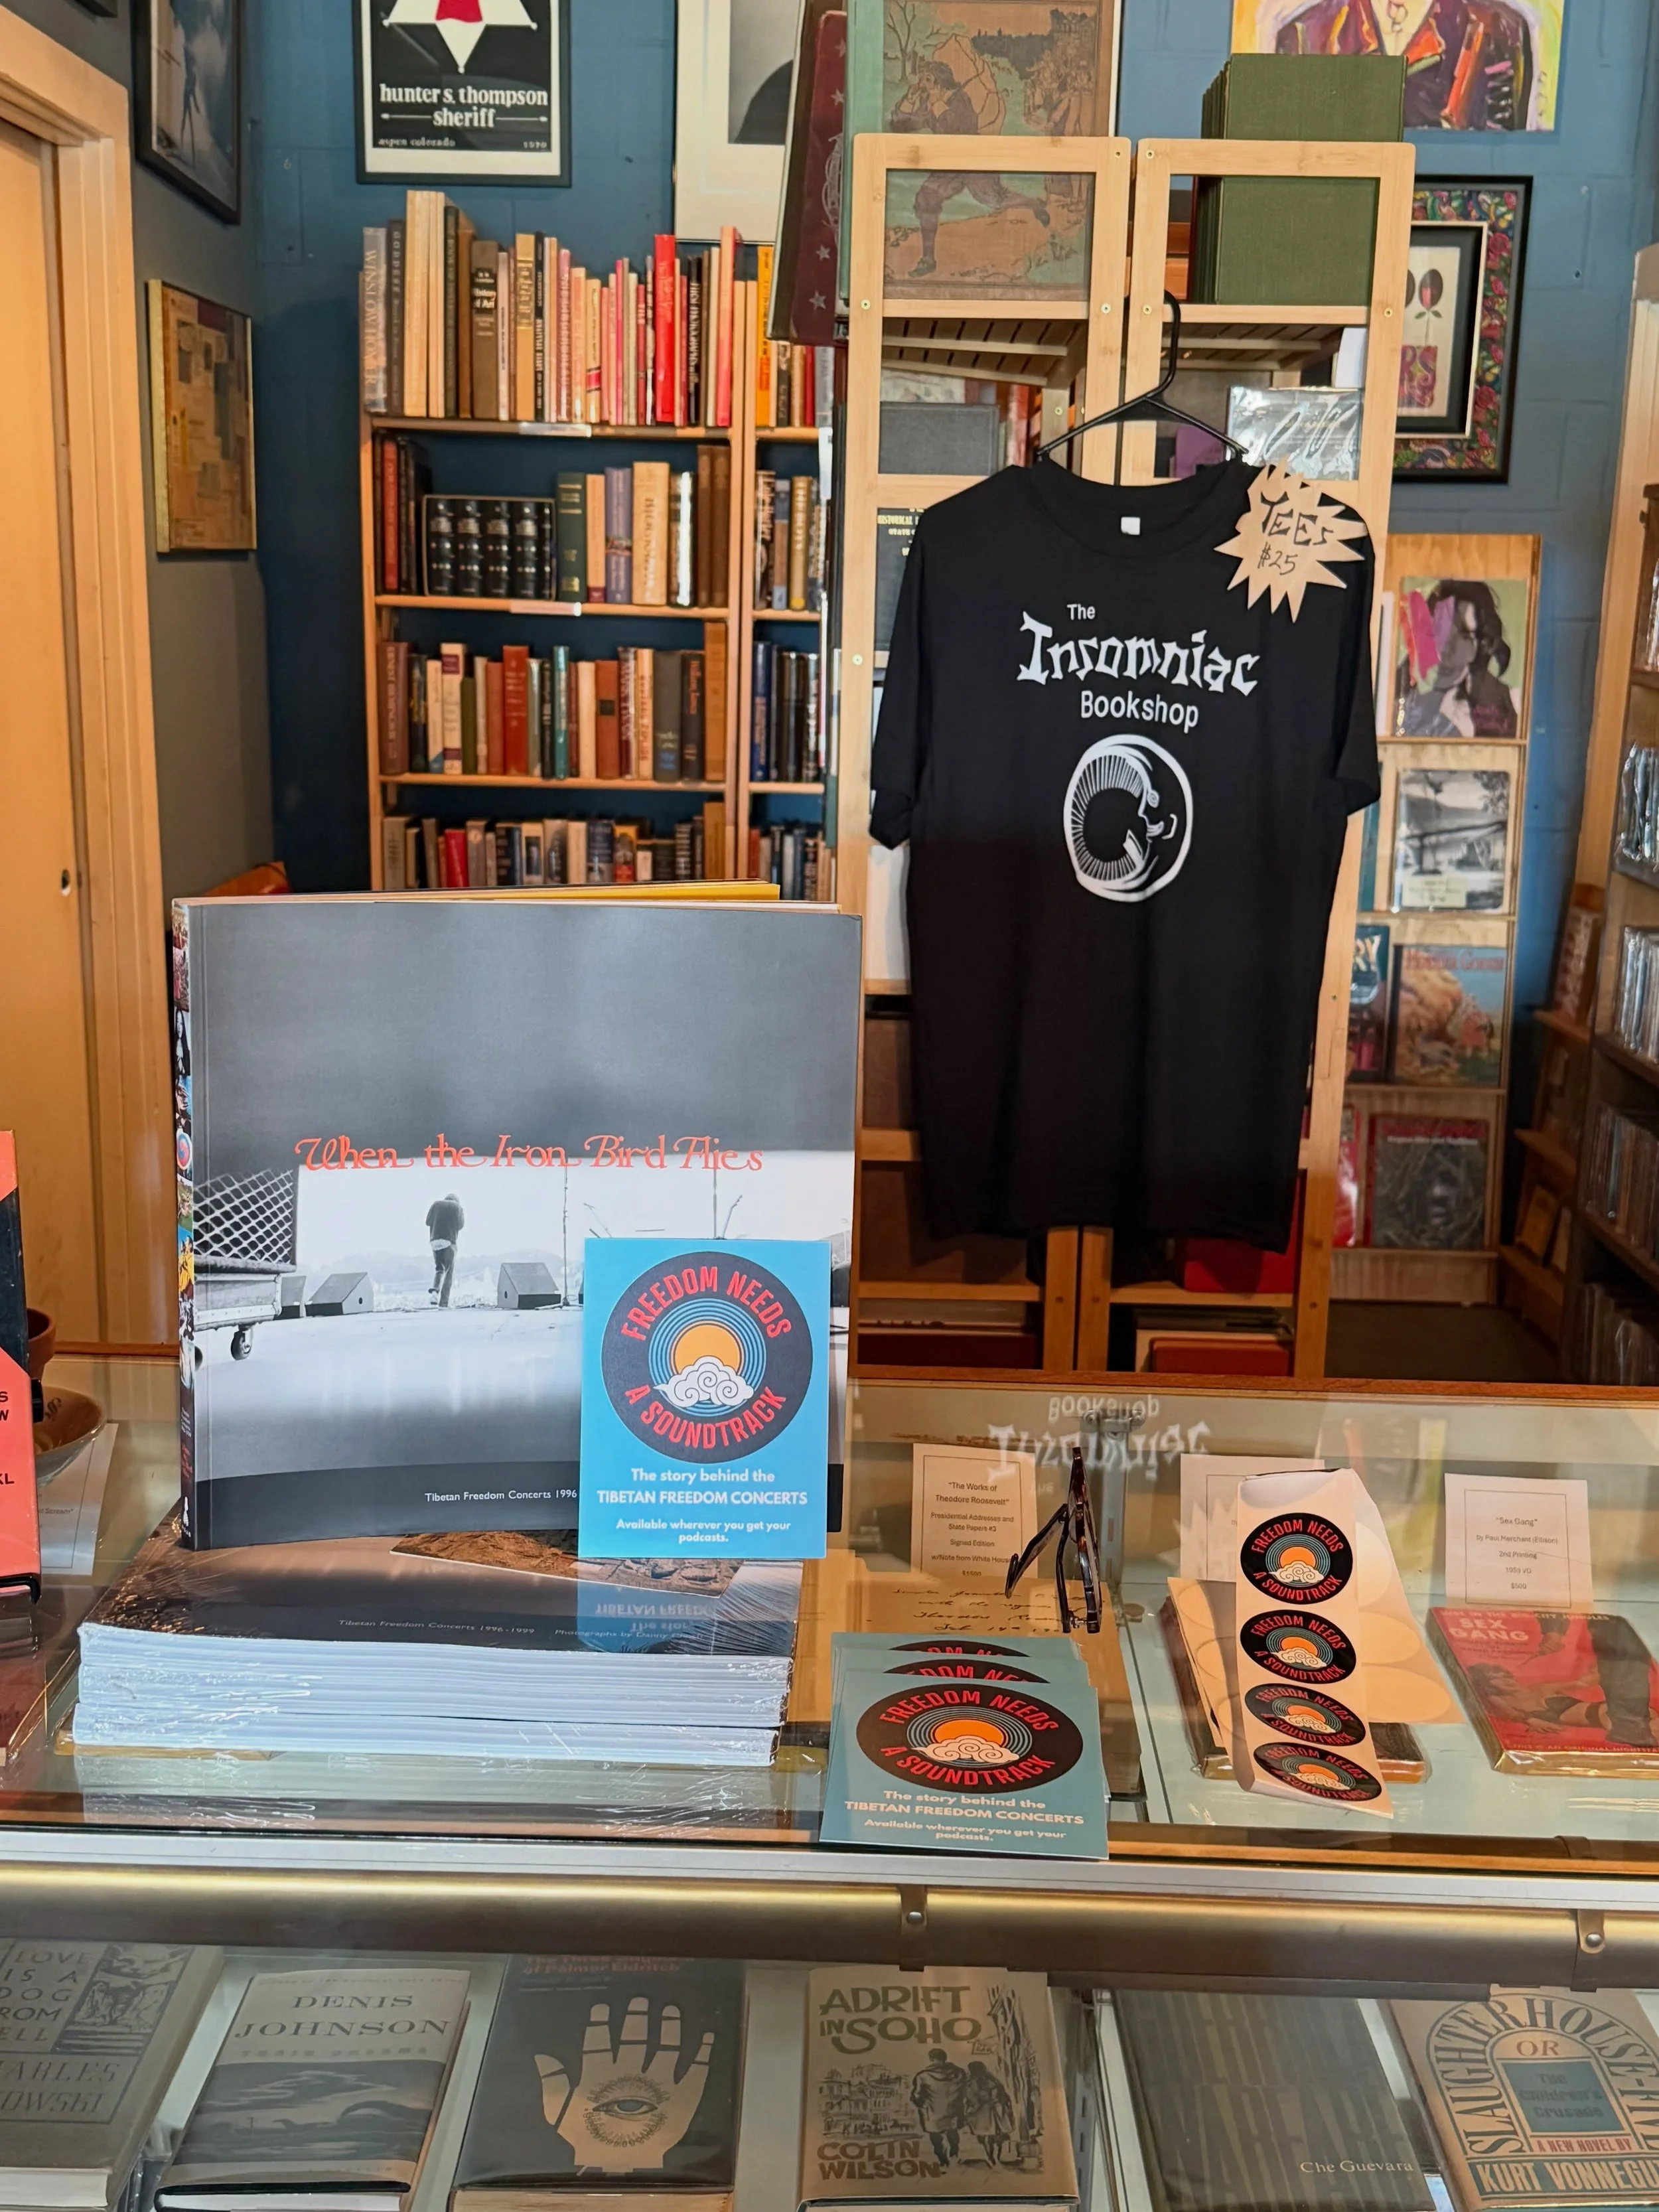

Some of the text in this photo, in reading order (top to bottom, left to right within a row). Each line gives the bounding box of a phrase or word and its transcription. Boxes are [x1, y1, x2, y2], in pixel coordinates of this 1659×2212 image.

[380, 84, 441, 104] hunter
[459, 86, 548, 108] thompson
[433, 106, 496, 127] sheriff
[378, 139, 407, 147] aspen
[410, 137, 456, 147] colorado
[1258, 542, 1298, 575] $25
[1067, 603, 1096, 621] The
[1017, 611, 1260, 697] Insomniac
[1080, 690, 1199, 734] Bookshop
[294, 1133, 763, 1171] When the Iron Bird Flies
[620, 1266, 792, 1341] FREEDOM NEEDS
[624, 1384, 786, 1450] A SOUNDTRACK
[631, 1467, 776, 1486] The story behind the
[425, 1489, 577, 1502] Tibetan Freedom Concerts 1996
[597, 1490, 808, 1505] TIBETAN FREEDOM CONCERTS
[616, 1518, 791, 1532] Available wherever you get your
[678, 1532, 729, 1544] podcasts.
[1251, 1519, 1344, 1553] FREEDOM NEEDS
[1512, 1551, 1537, 1560] Printing
[1253, 1571, 1342, 1601] A SOUNDTRACK
[428, 1622, 475, 1631] Concerts
[1250, 1615, 1346, 1649] FREEDOM NEEDS
[1459, 1618, 1508, 1629] SEX
[1449, 1627, 1529, 1641] GANG
[1263, 1657, 1346, 1682] SOUNDTRACK
[879, 1690, 1059, 1731] FREEDOM NEEDS
[1256, 1688, 1354, 1722] FREEDOM NEEDS
[1271, 1720, 1356, 1745] SOUNDTRACK
[881, 1745, 1056, 1786] A SOUNDTRACK
[1264, 1746, 1369, 1779] FREEDOM NEEDS
[883, 1791, 1046, 1809] The story behind the
[845, 1801, 1084, 1825] TIBETAN FREEDOM CONCERTS
[865, 1818, 922, 1830] Available
[926, 1823, 985, 1833] wherever
[1014, 1829, 1034, 1838] get
[1038, 1831, 1066, 1840] your
[935, 1830, 993, 1841] podcasts.
[14, 1951, 92, 1964] LOVE
[3, 1968, 78, 1982] IS A
[292, 1995, 414, 2008] DENIS
[819, 1986, 971, 2016] ADRIFT
[0, 2008, 63, 2021] ROM
[0, 2027, 48, 2041] ELL
[234, 2020, 451, 2038] JOHNSON
[820, 2018, 844, 2037] IN
[831, 2016, 982, 2055] SOHO
[1516, 2040, 1559, 2056] OR
[0, 2061, 120, 2081] ARLES
[817, 2140, 920, 2162] COLIN
[1537, 2138, 1632, 2152] A NEW NOVEL BY
[819, 2160, 941, 2180] WILSON
[1300, 2160, 1414, 2172] Che Guevara
[1476, 2160, 1659, 2192] KURT VONNEGU
